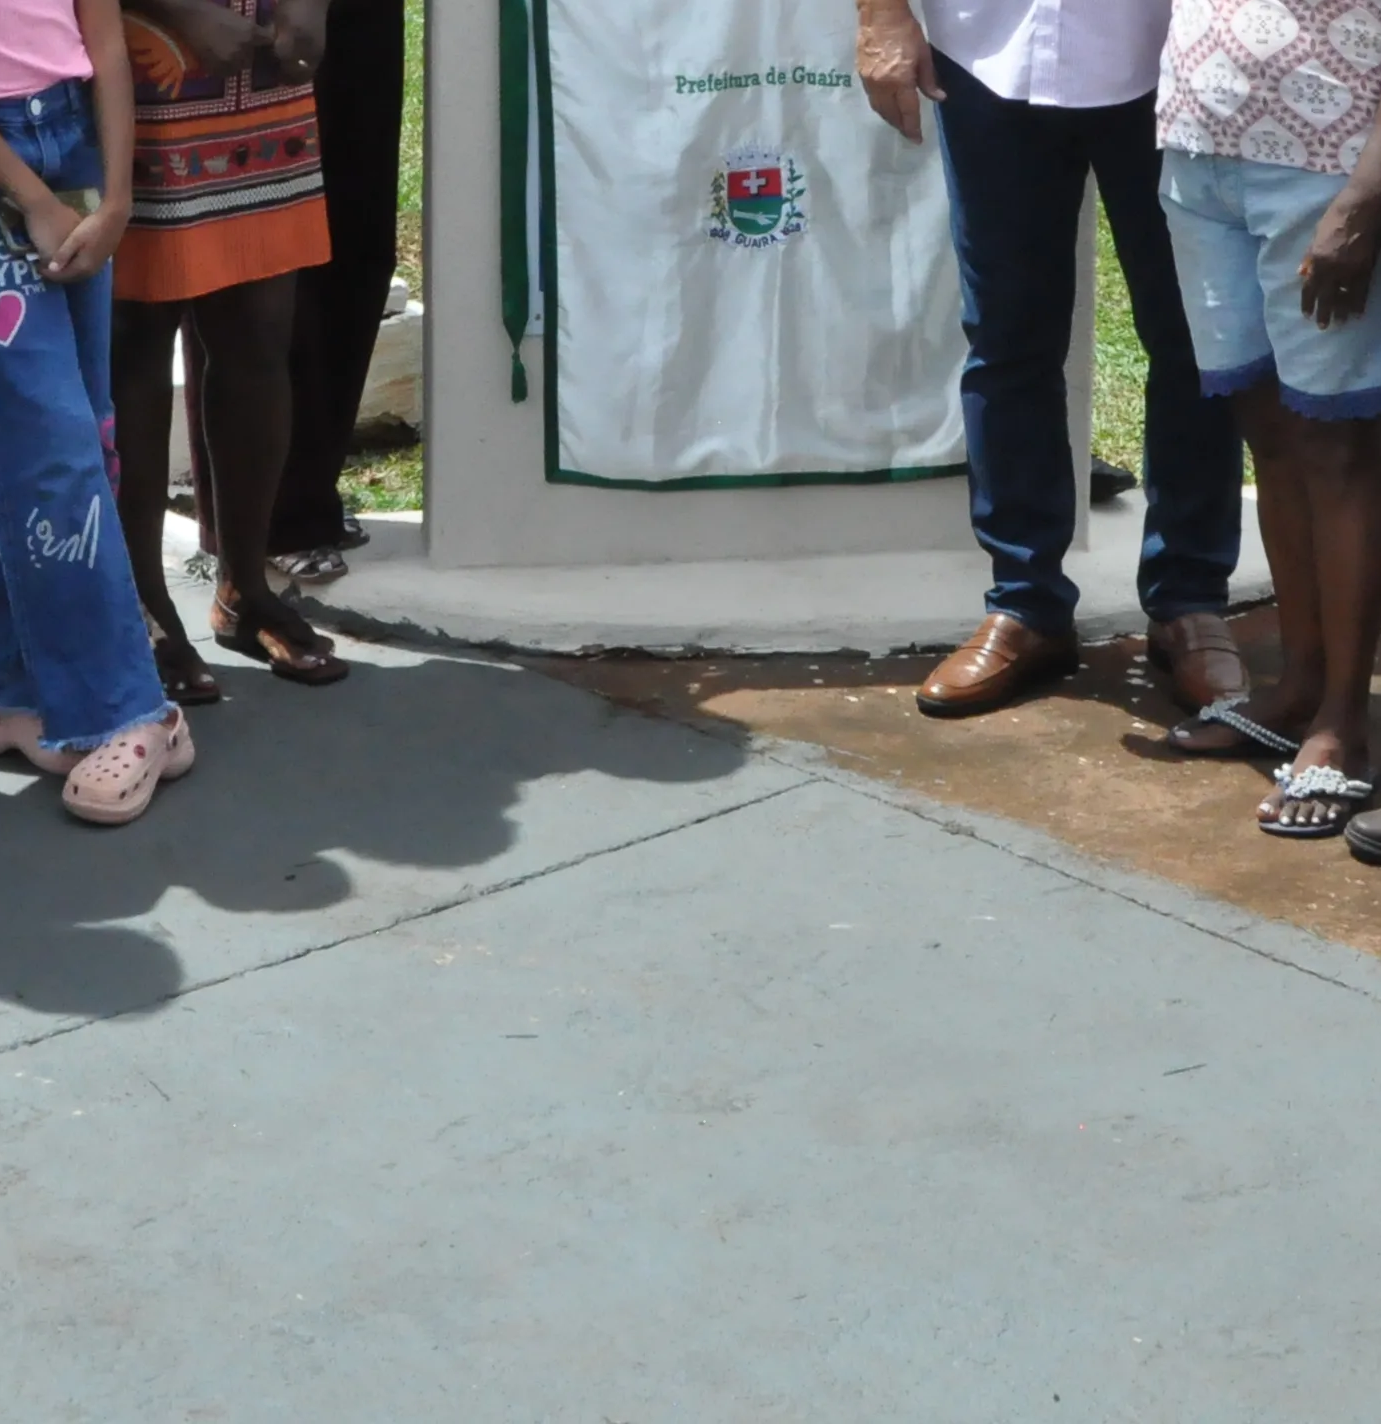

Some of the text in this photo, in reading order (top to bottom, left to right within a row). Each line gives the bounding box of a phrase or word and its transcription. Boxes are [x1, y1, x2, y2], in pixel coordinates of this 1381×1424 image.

[675, 66, 852, 94] Prefeitura de Guaíra
